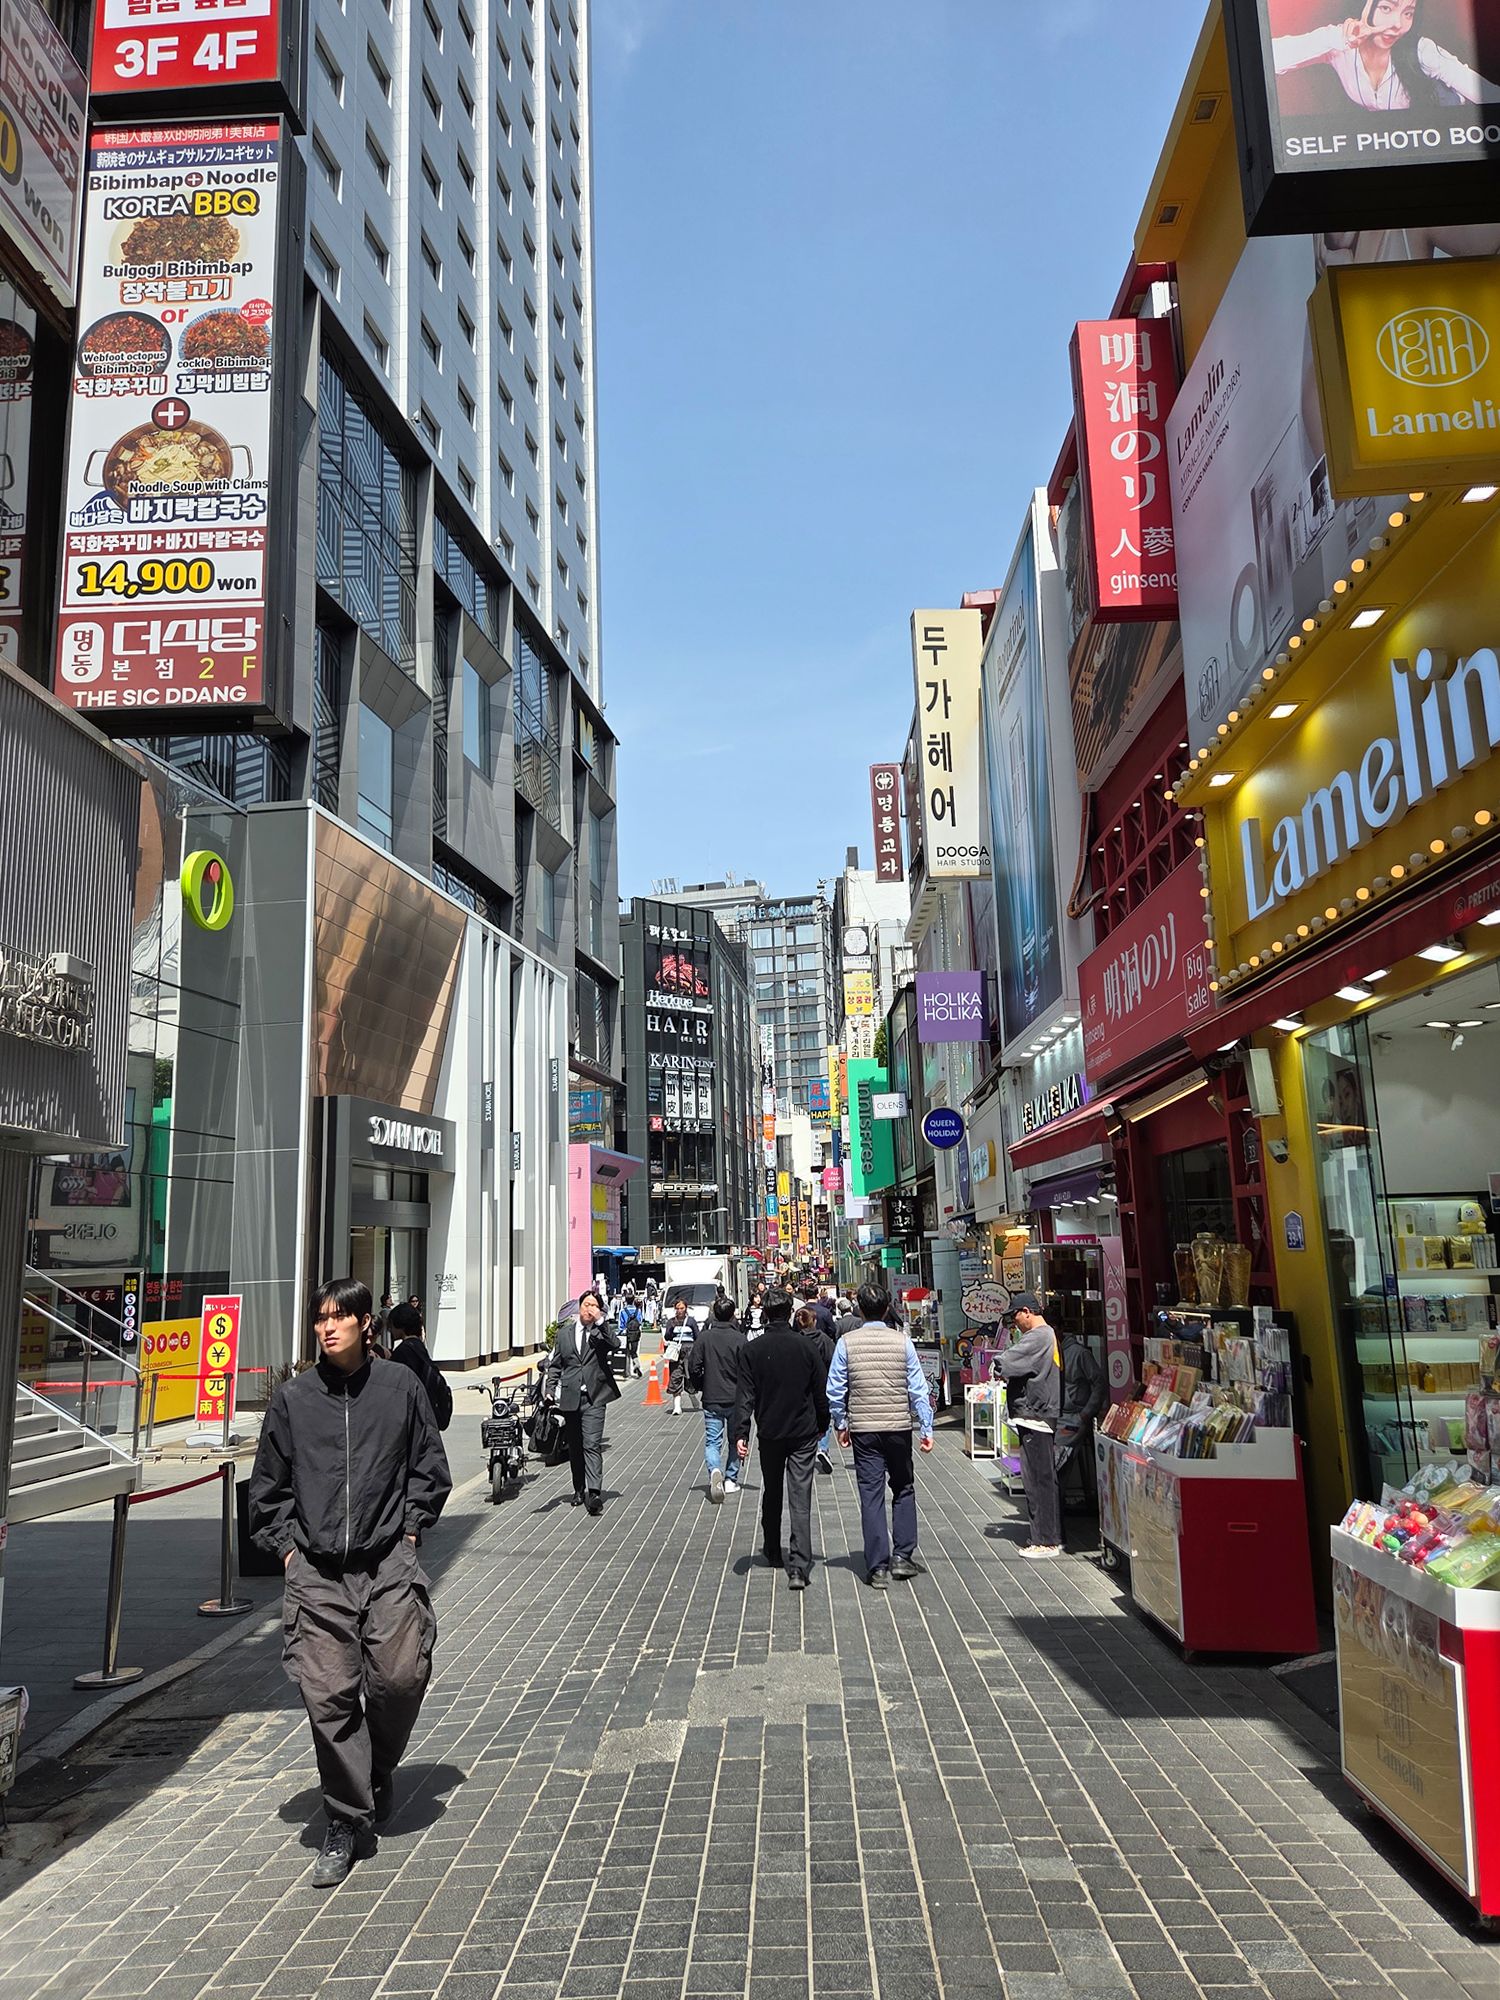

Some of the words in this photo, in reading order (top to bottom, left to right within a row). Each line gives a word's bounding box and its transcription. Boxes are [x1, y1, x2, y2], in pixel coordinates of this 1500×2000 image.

[114, 36, 179, 78] 3F
[193, 30, 258, 71] 4F
[4, 9, 80, 142] Noodle
[1285, 134, 1348, 157] SELF
[1356, 128, 1441, 152] PHOTO
[89, 174, 183, 191] Bibimbap
[207, 169, 277, 186] Noodle
[24, 177, 64, 253] won
[105, 196, 189, 219] KOREA
[194, 190, 259, 217] BBQ
[103, 264, 162, 280] Bulgogi
[168, 261, 253, 278] Bibimbap
[121, 280, 232, 303] 장작불고기
[160, 308, 189, 324] or
[84, 353, 124, 363] Webfoot
[127, 351, 166, 363] octopus
[95, 363, 153, 376] Bibimbap
[177, 358, 211, 369] cockle
[216, 356, 272, 369] Bibimbap
[76, 376, 167, 396] 직화쭈꾸미
[177, 373, 270, 394] 꼬막비빔밥
[1100, 330, 1161, 512] 明洞のり
[1177, 359, 1225, 465] Lamelin
[1367, 399, 1500, 438] Lameli
[129, 482, 170, 494] Noodle
[173, 480, 204, 493] Soup
[205, 479, 230, 491] with
[233, 478, 269, 491] Clams
[130, 496, 266, 521] 바지락칼국수
[1110, 527, 1174, 558] 人蔘
[78, 560, 213, 595] 14,900
[217, 577, 257, 591] won
[113, 617, 262, 656] 더식당
[71, 629, 95, 676] 명동
[73, 689, 117, 707] THE
[122, 688, 161, 705] SIC
[165, 685, 247, 703] DDANG
[922, 626, 957, 828] 두가헤어
[1240, 648, 1500, 922] Lamelin
[877, 795, 899, 875] 명동교자
[936, 845, 990, 858] DOOGA
[936, 859, 957, 867] HAIR
[960, 858, 991, 867] STUDIO
[1103, 911, 1177, 1025] 明洞のり
[1186, 954, 1203, 983] Big
[923, 992, 983, 1007] HOLIKA
[1188, 984, 1208, 1014] sale
[646, 1014, 708, 1037] HAIR
[924, 1006, 983, 1022] HOLIKA
[650, 1053, 695, 1069] KARIN
[876, 1100, 904, 1110] OLENS
[857, 1079, 874, 1175] innisfree
[927, 1129, 960, 1138] HOLIDAY
[929, 1119, 955, 1128] QUEEN
[413, 1126, 444, 1156] HOTEL
